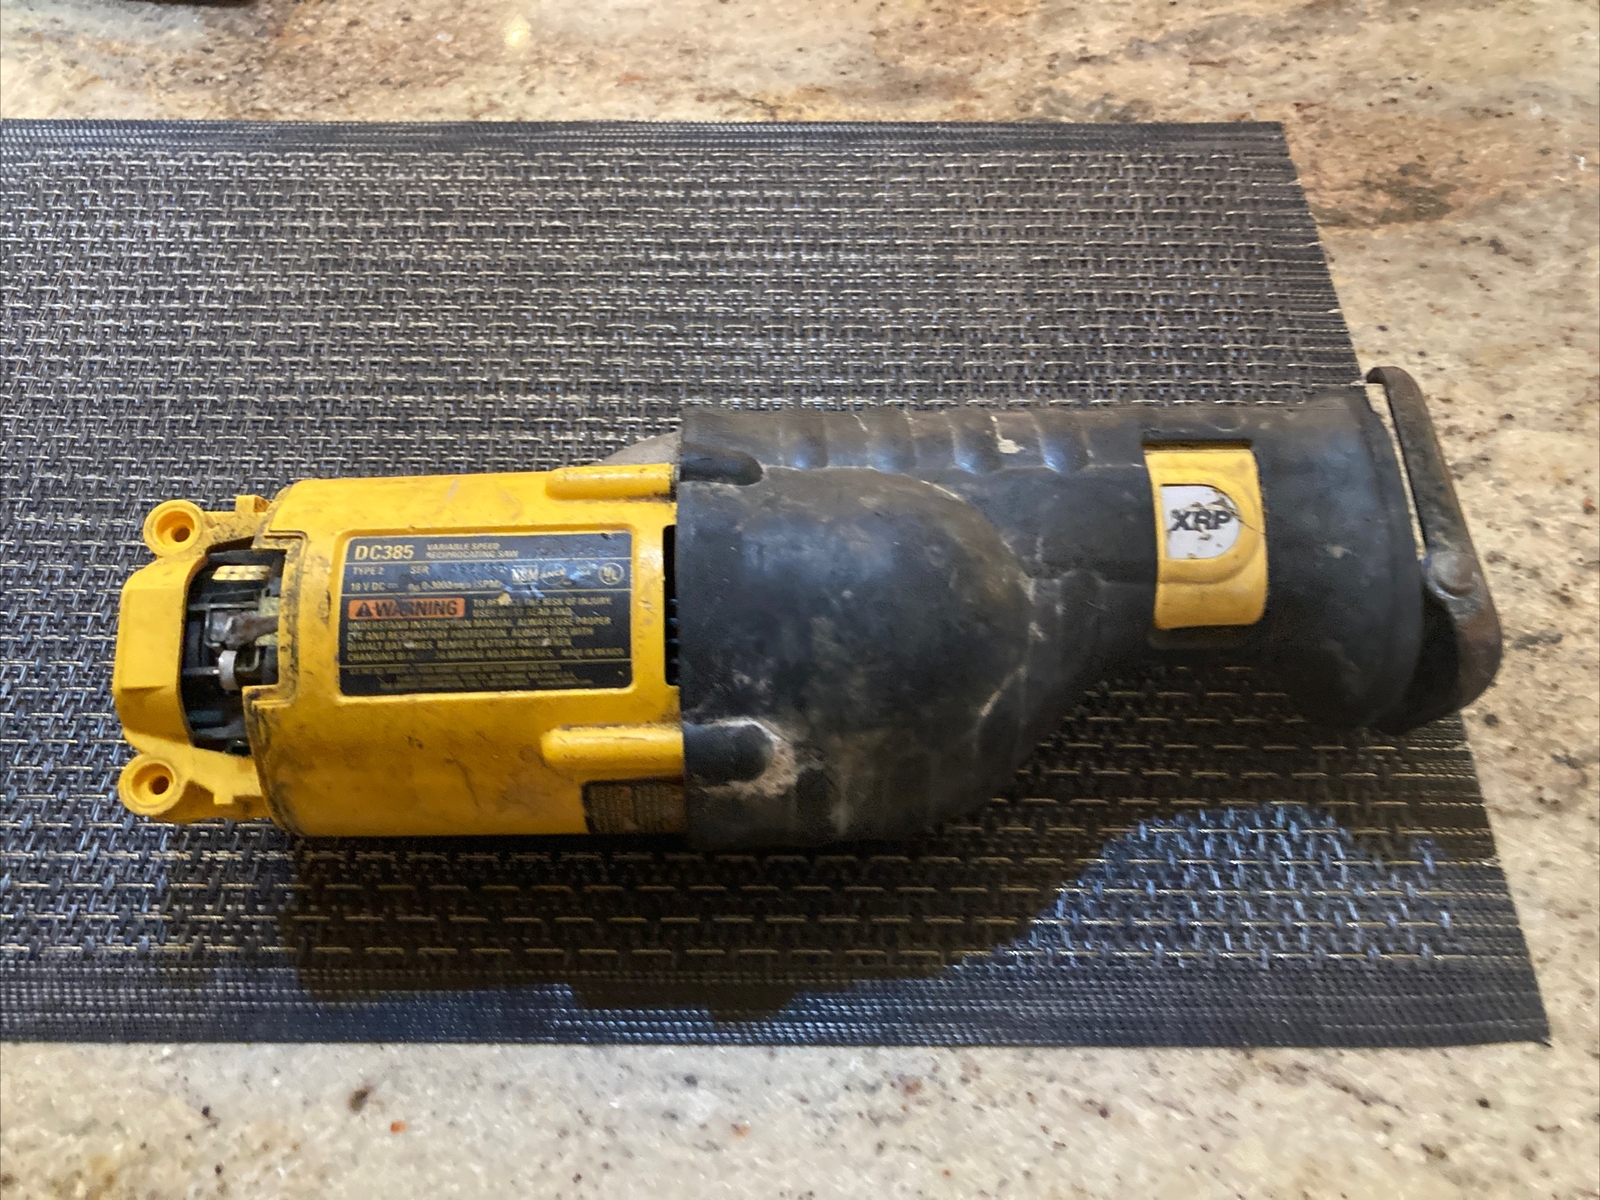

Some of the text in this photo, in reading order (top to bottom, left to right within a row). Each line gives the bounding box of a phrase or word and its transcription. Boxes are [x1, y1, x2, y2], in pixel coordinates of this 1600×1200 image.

[1170, 508, 1231, 531] XRP
[427, 542, 500, 551] VARIABLE SPEED
[354, 544, 415, 560] DC385
[497, 550, 519, 558] SAW
[353, 566, 385, 575] TYPE 2
[410, 565, 430, 575] SER
[363, 582, 370, 591] V
[371, 582, 386, 591] DC
[473, 599, 485, 607] TO
[542, 597, 563, 606] RISK
[564, 597, 576, 605] OF
[472, 609, 496, 617] USER
[552, 607, 573, 616] AND
[347, 621, 409, 630] UNDERSTAND
[410, 619, 472, 629] INSTRUCTION
[365, 631, 385, 640] AND
[387, 630, 447, 640] RESPIRATORY
